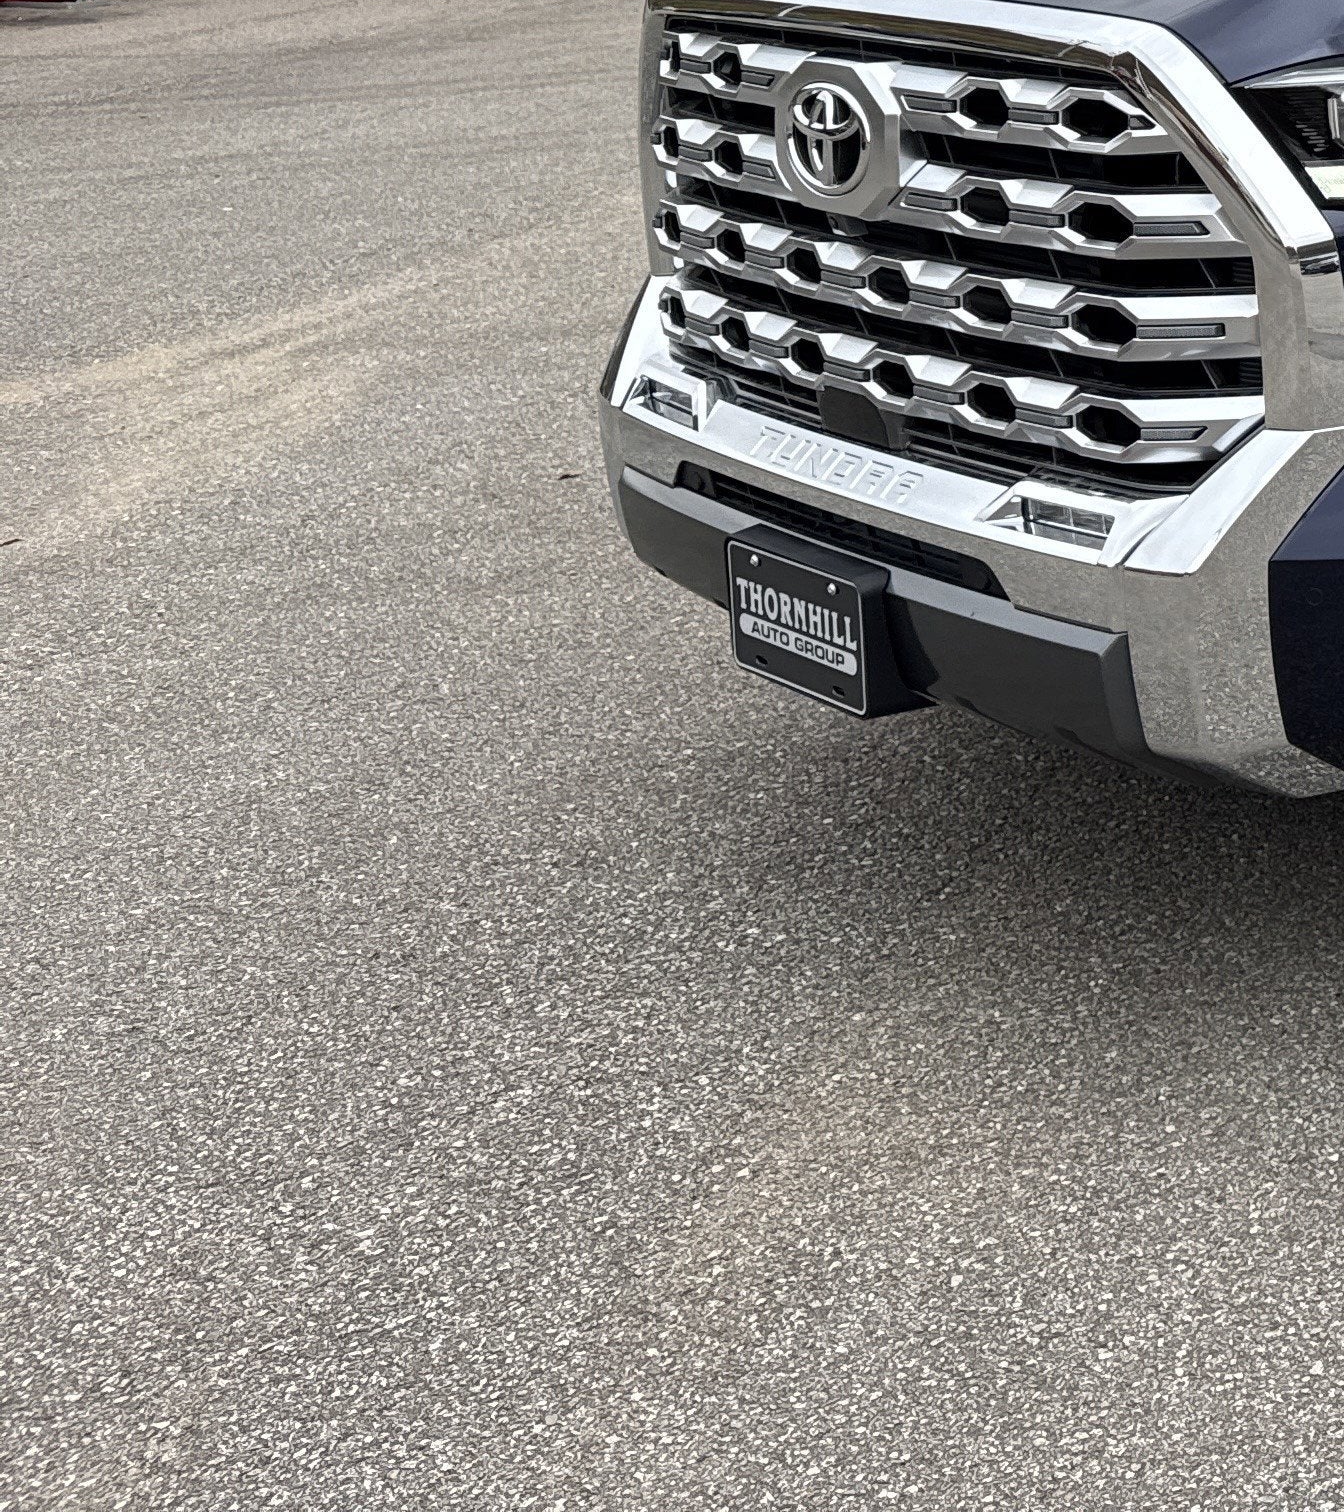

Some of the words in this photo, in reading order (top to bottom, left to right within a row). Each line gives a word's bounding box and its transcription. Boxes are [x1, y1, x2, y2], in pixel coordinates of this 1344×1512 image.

[750, 425, 924, 504] TUNDRA
[736, 577, 858, 652] THORNHILL
[751, 620, 790, 647] AUTO
[794, 637, 845, 667] GROUP
